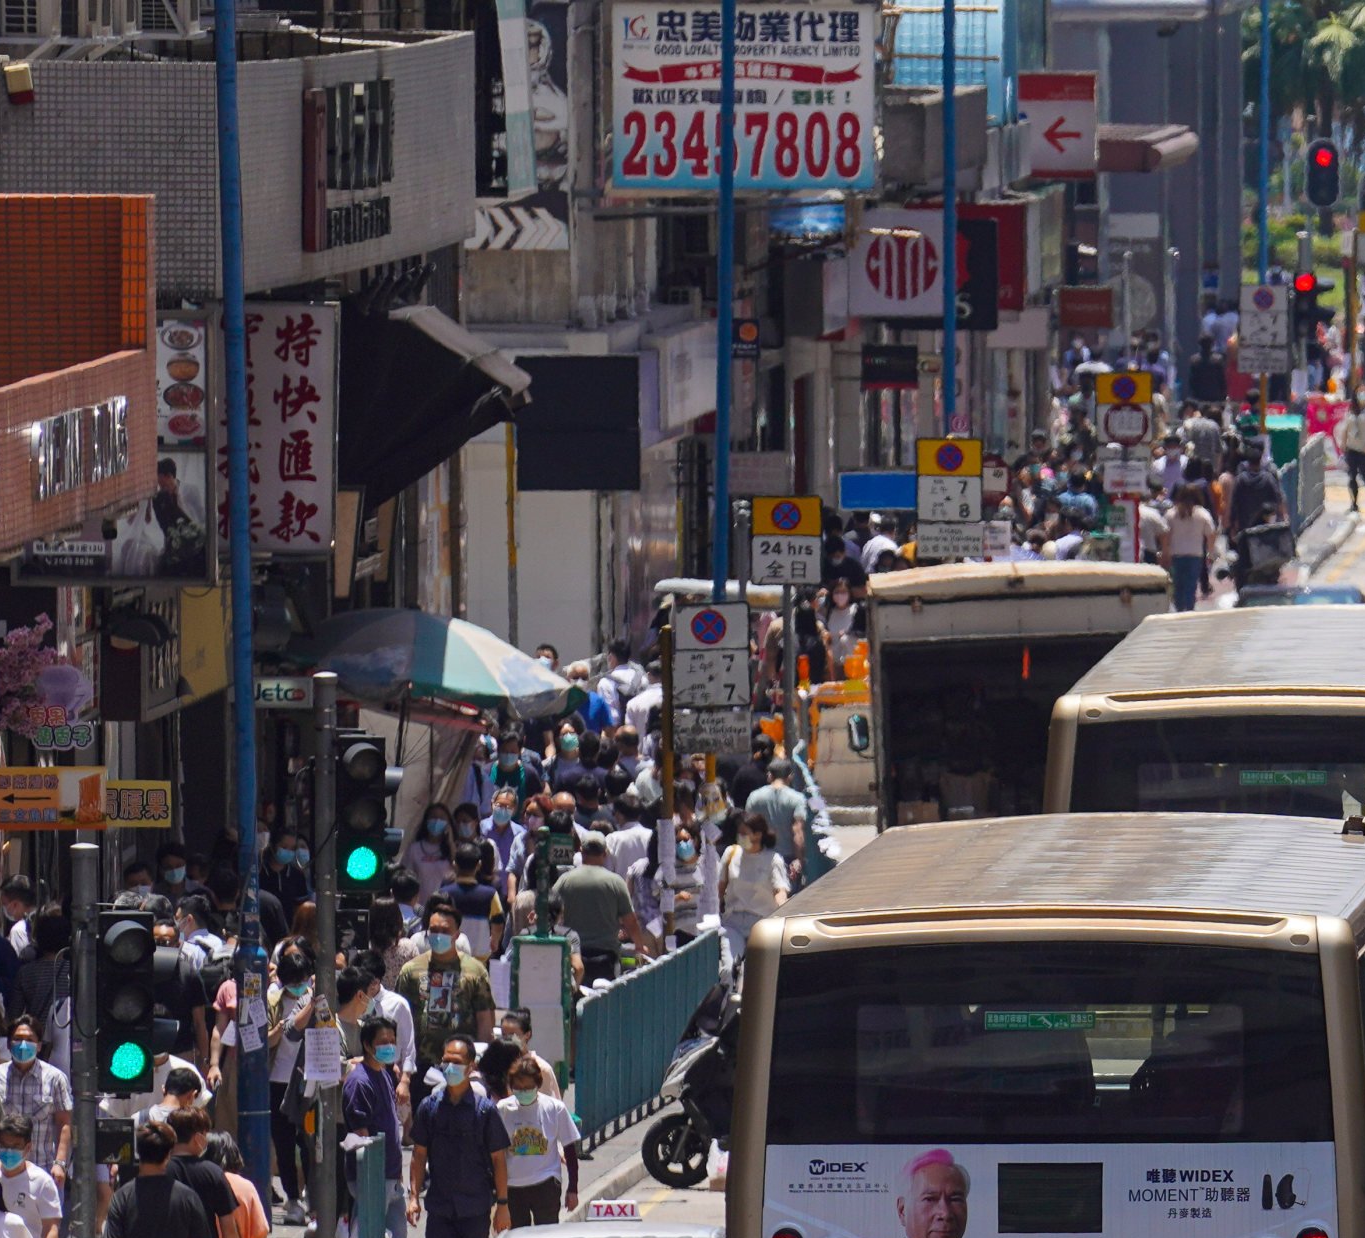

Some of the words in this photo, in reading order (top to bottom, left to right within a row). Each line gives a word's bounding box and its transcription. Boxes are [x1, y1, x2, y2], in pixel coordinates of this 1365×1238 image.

[654, 44, 682, 57] GOOD
[685, 44, 723, 57] LOYALT
[734, 44, 777, 57] ROPERTY
[780, 44, 820, 57] AGENCY
[822, 44, 861, 57] LIMITED
[273, 312, 322, 544] 特快匯款
[957, 480, 968, 495] 7
[958, 502, 970, 519] 8
[760, 540, 783, 556] 24
[787, 540, 813, 556] hrs
[765, 561, 807, 579] 全日
[721, 653, 735, 673] 7
[722, 683, 736, 701] 7
[808, 1158, 866, 1176] WIDEX
[1146, 1168, 1177, 1184] 唯聽
[1179, 1169, 1235, 1183] WIDEX
[1128, 1188, 1199, 1203] MOMENT
[1205, 1187, 1251, 1203] 助聽器
[592, 1204, 636, 1217] TAXI
[1167, 1207, 1213, 1220] 丹麥製造
